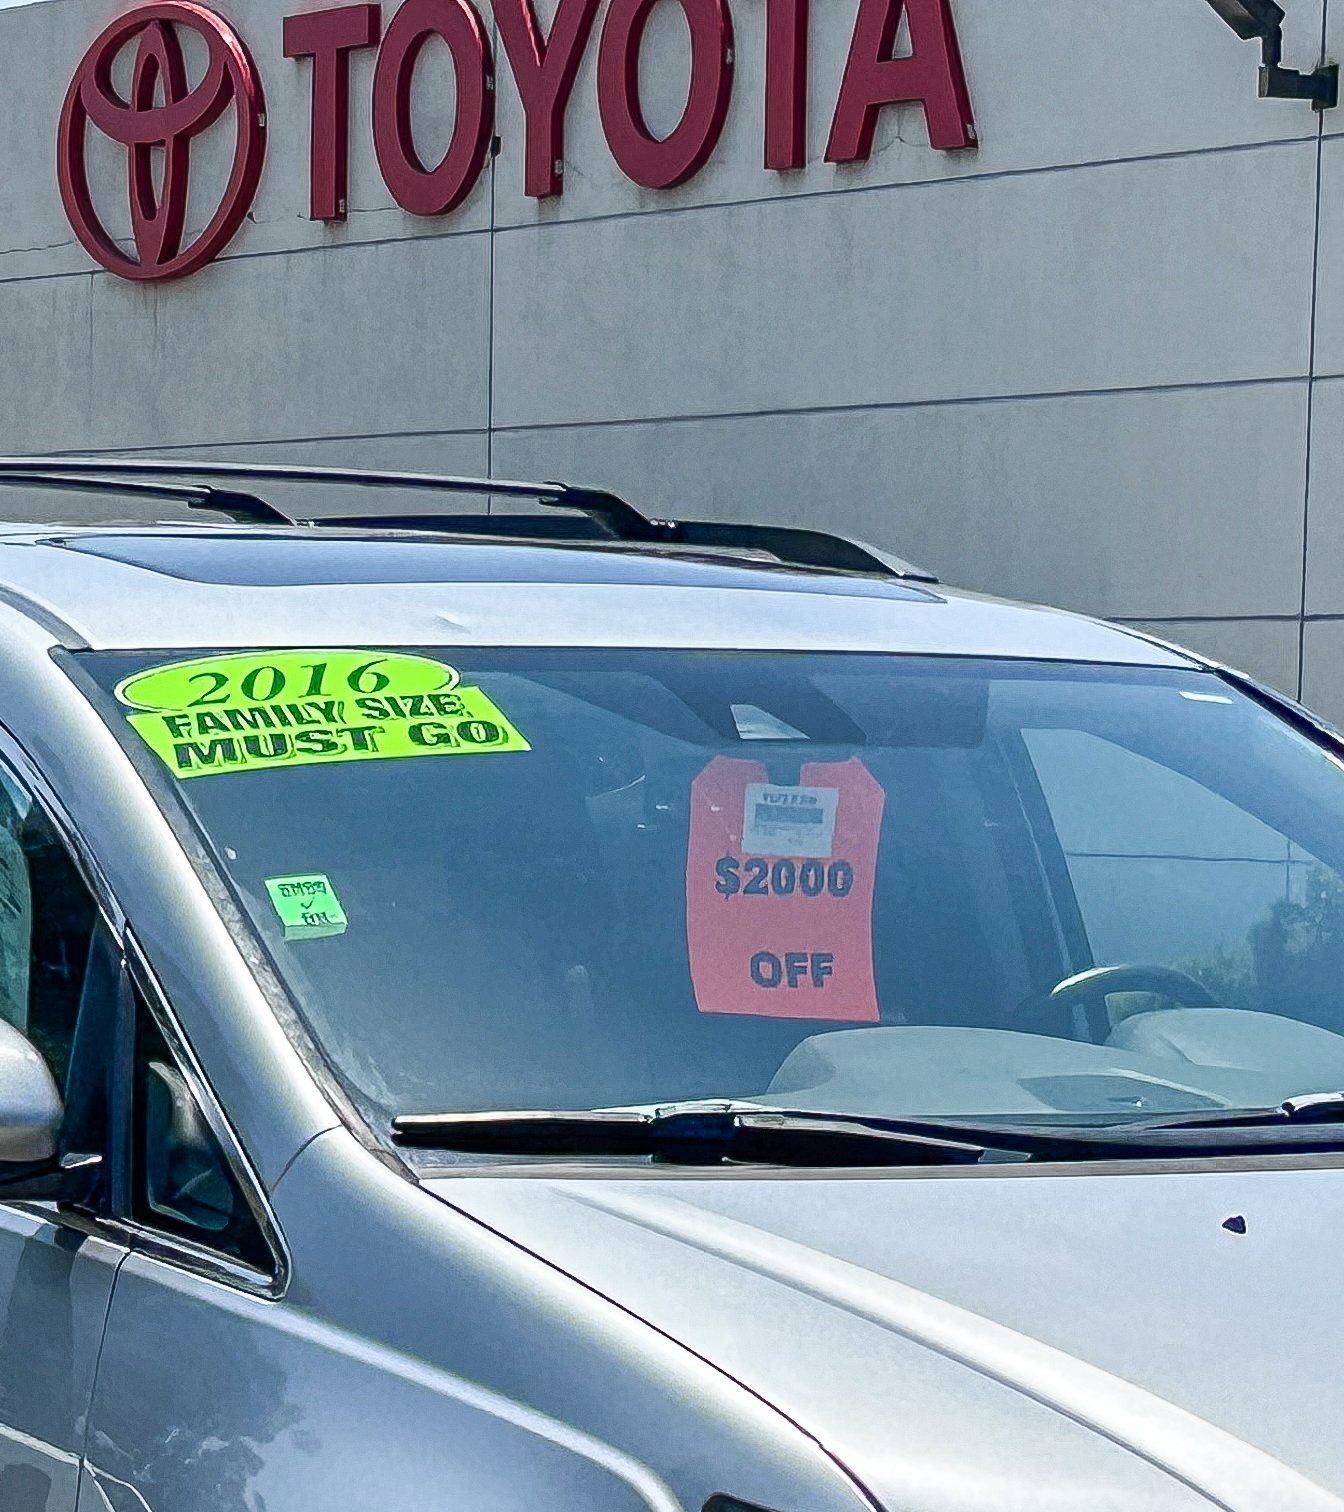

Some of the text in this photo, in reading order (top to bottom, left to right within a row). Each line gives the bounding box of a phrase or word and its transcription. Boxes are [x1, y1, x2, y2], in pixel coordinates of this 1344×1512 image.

[187, 659, 389, 708] 2016
[162, 694, 467, 738] FAMILY SIZE
[174, 720, 506, 769] MUST GO
[715, 856, 854, 900] $2000
[750, 951, 834, 989] OFF
